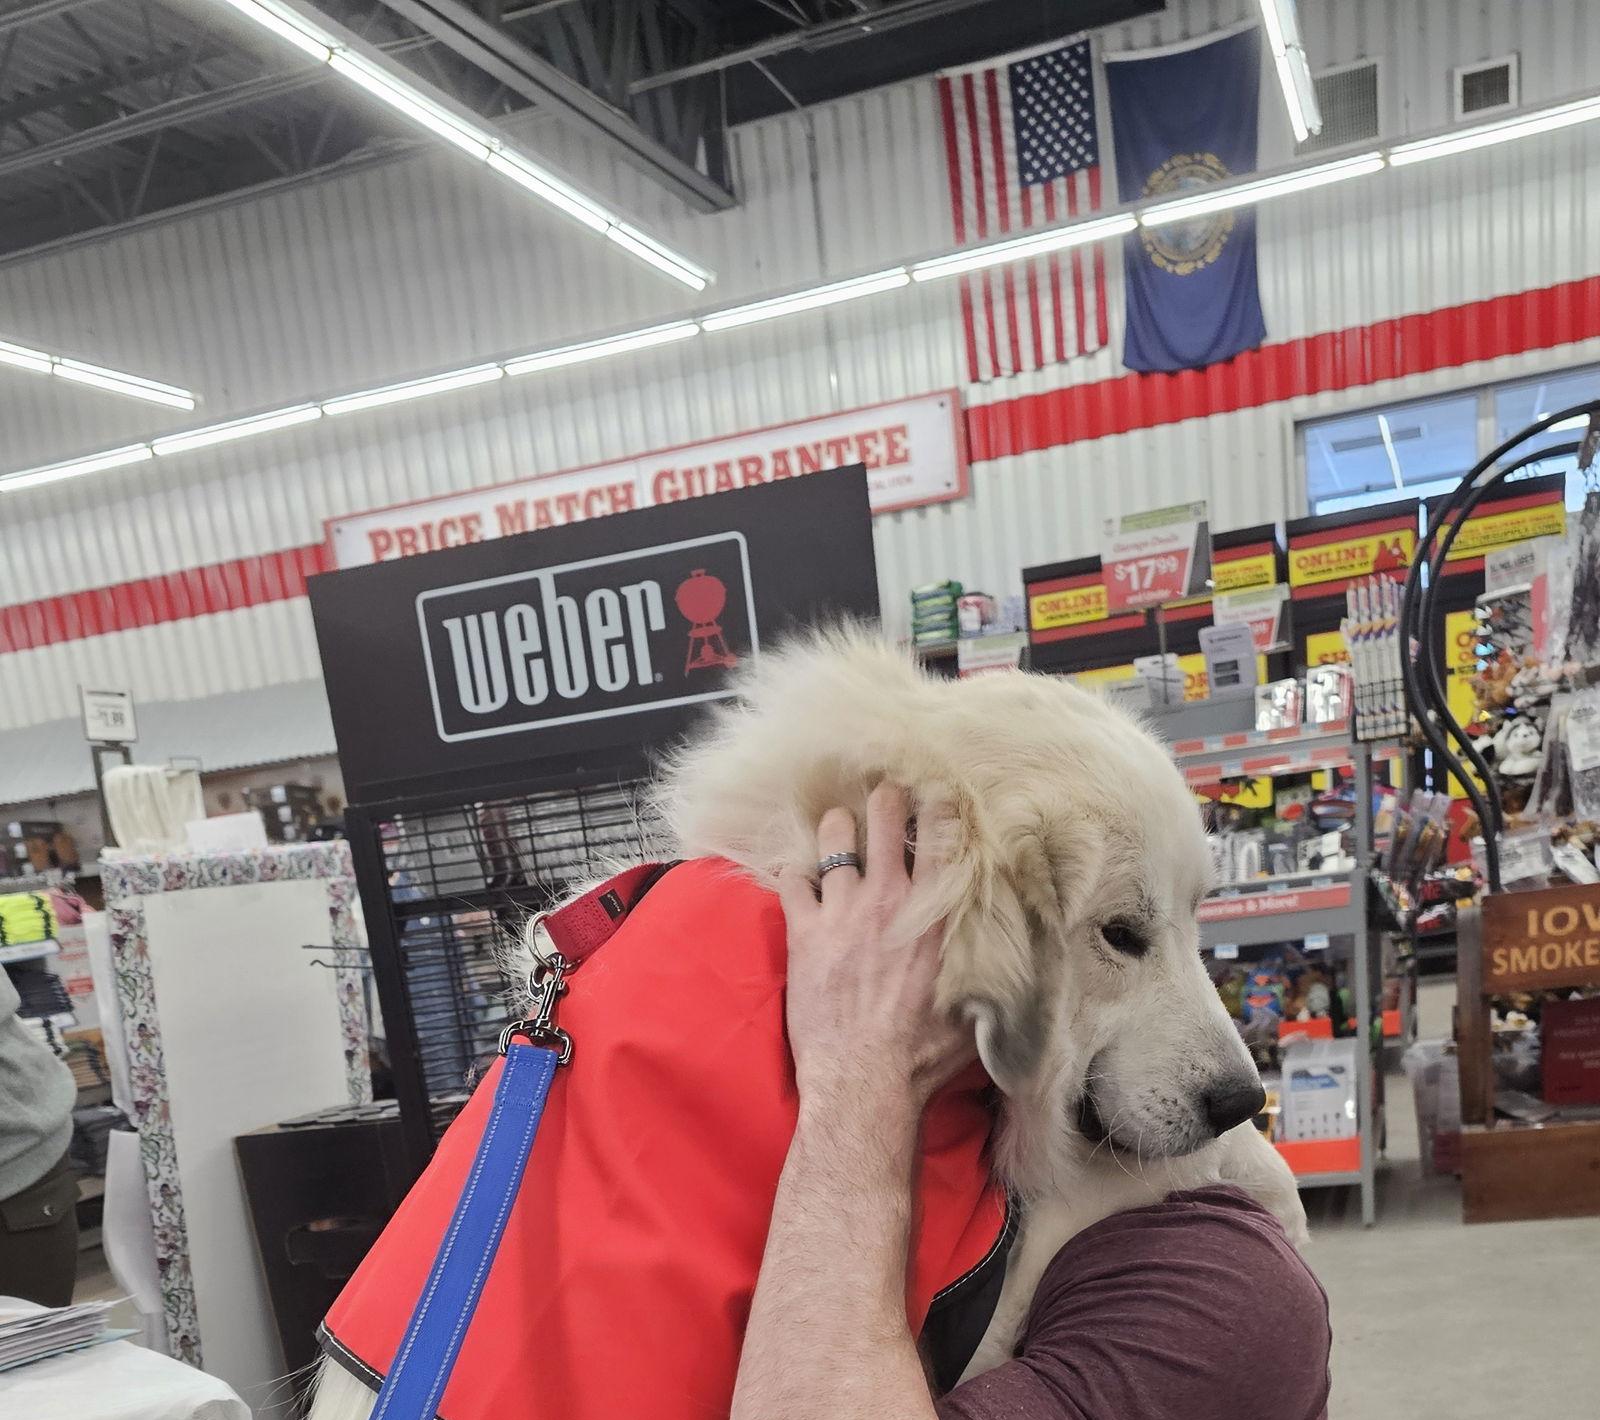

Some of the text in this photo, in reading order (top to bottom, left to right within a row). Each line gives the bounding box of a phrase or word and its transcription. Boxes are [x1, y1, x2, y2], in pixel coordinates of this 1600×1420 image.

[368, 424, 911, 563] PRICE MATCH GUARANTEE
[442, 574, 666, 714] weber
